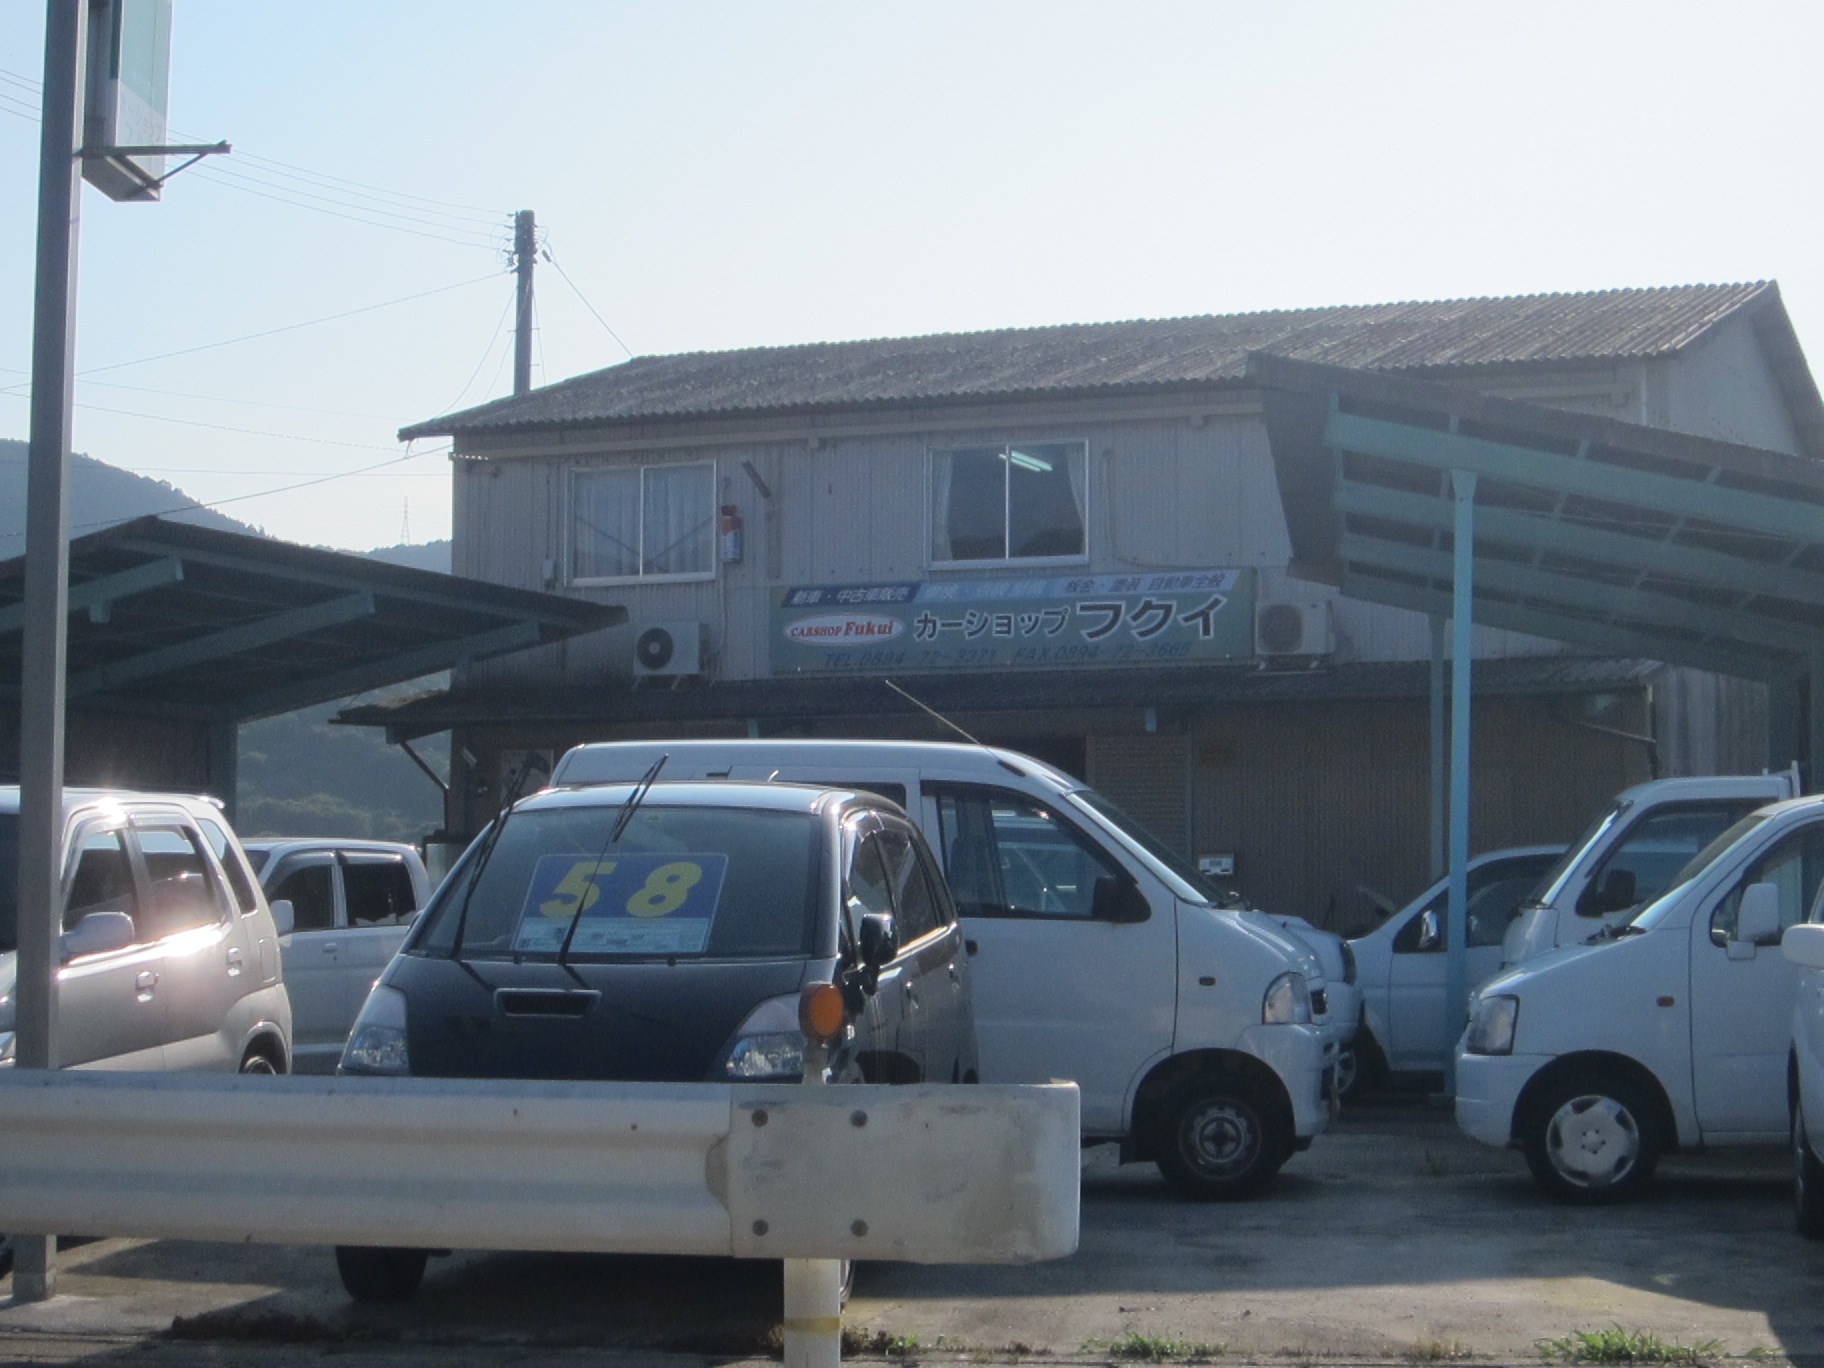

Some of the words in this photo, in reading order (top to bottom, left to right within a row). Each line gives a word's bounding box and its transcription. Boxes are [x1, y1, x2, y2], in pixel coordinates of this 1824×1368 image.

[843, 620, 893, 637] Fukui
[914, 605, 1070, 642] カーショップ
[1076, 593, 1227, 642] フクイ
